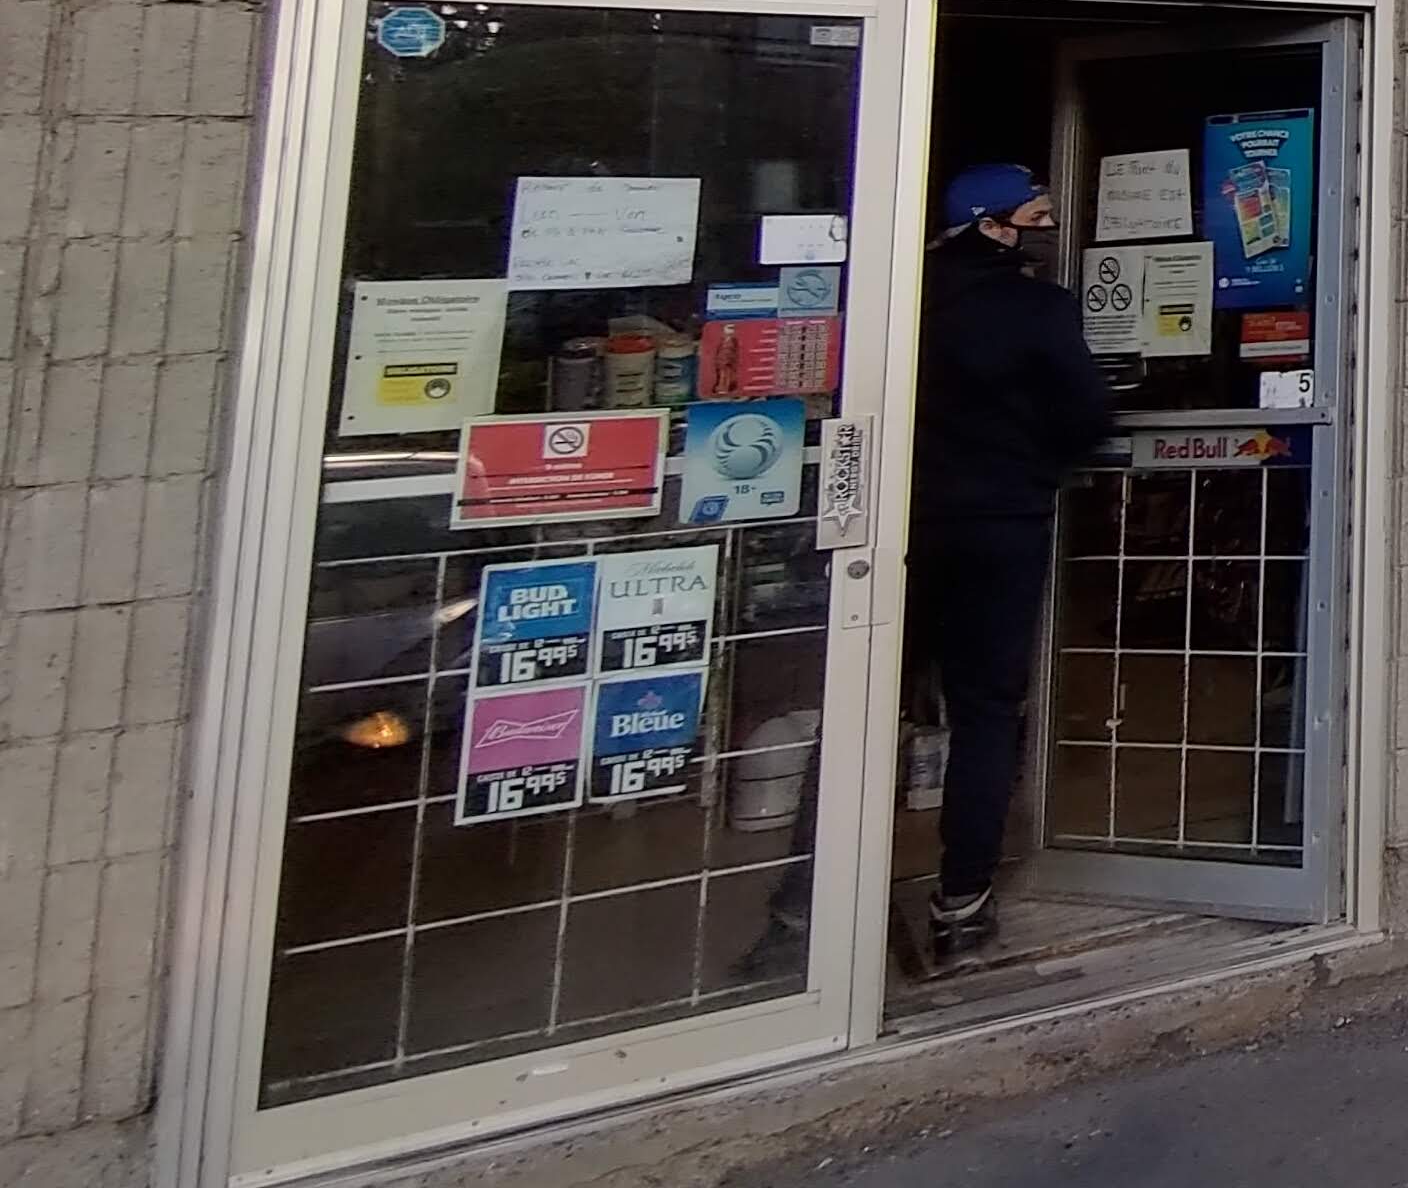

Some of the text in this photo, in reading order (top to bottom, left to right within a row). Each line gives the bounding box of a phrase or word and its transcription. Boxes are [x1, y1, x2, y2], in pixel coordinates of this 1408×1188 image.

[1298, 373, 1310, 393] 5
[1154, 437, 1228, 459] Red Bull
[510, 584, 569, 605] BUD
[610, 575, 708, 599] ULTRA
[497, 599, 577, 622] LIGHT
